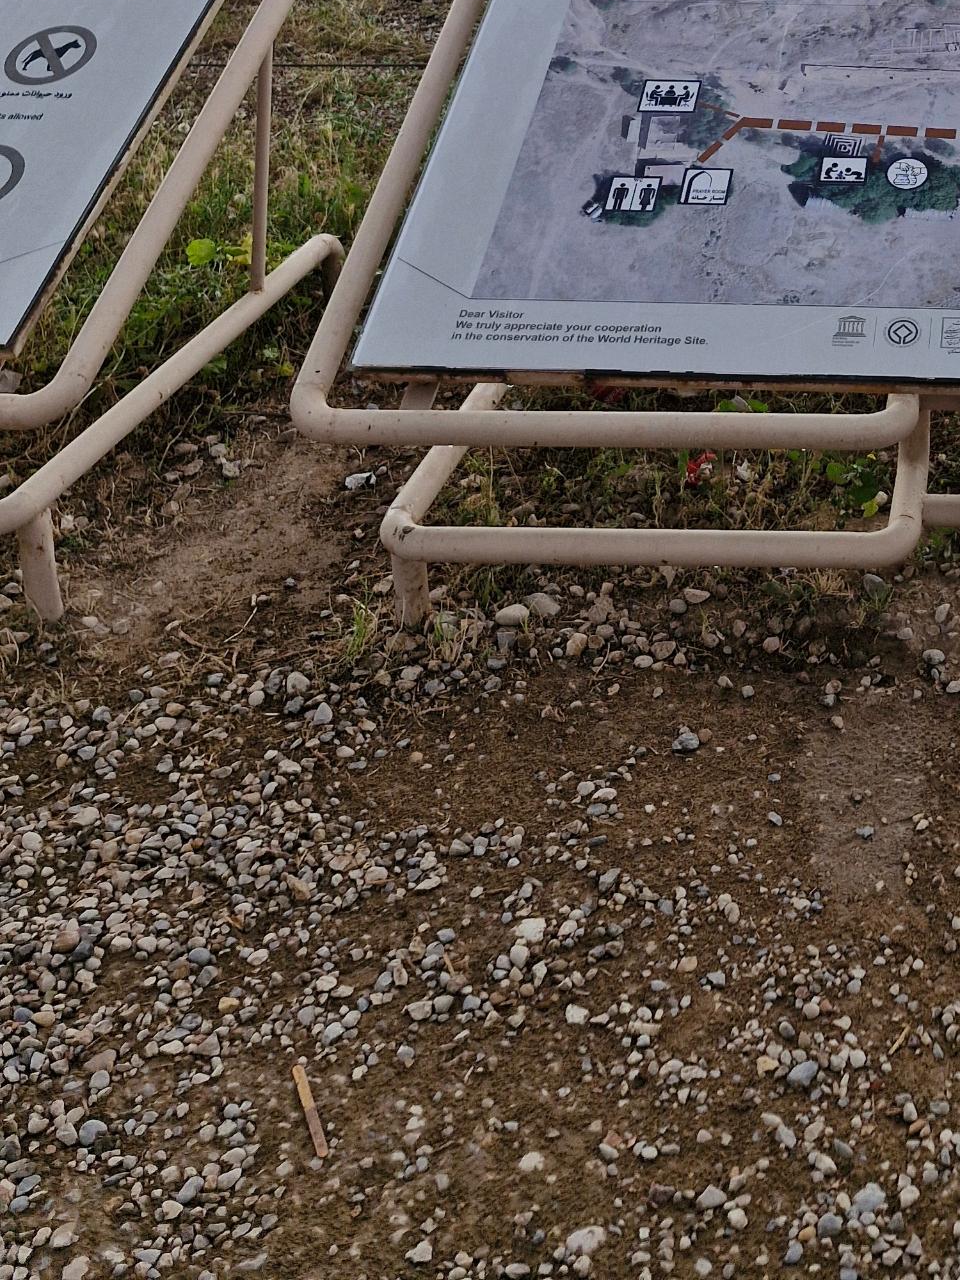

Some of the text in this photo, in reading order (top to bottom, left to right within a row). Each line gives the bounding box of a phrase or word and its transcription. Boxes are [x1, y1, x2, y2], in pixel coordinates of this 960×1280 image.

[0, 90, 20, 98] ممنو
[8, 112, 44, 120] allowed
[459, 310, 525, 319] Dear Visitor
[456, 320, 662, 334] We truly appreciate your cooperation
[451, 331, 709, 346] in the conservation of the World Heritage Site.
